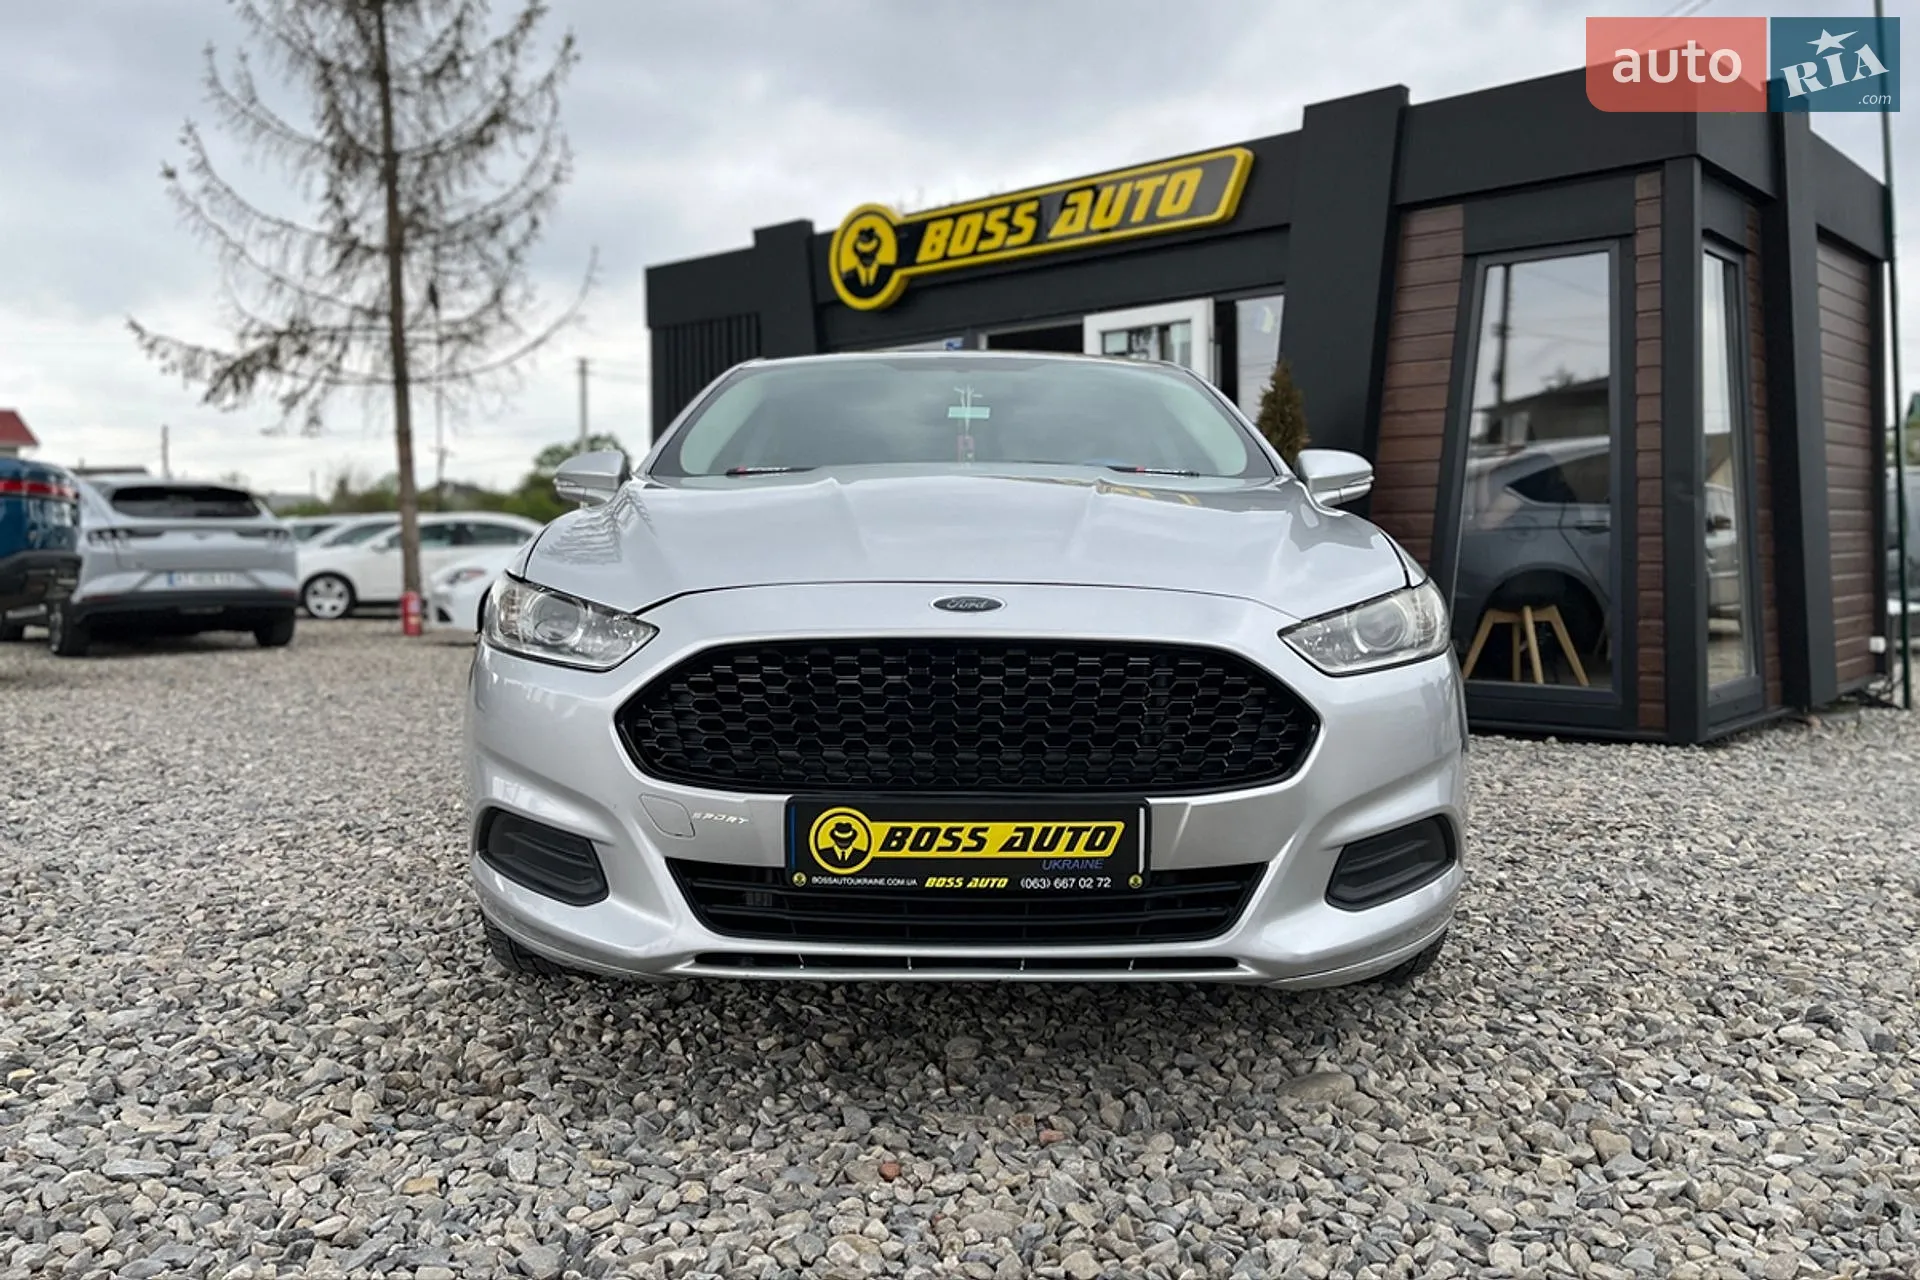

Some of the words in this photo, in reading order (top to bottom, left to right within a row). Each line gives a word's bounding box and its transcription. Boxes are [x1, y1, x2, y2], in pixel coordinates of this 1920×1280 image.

[915, 198, 1040, 264] BOSS
[1048, 167, 1203, 239] AUTO
[946, 598, 988, 610] Ford
[878, 825, 990, 853] BOSS
[997, 825, 1119, 853] AUTO
[1041, 859, 1105, 871] UKRAINE
[924, 876, 963, 888] BOSS
[966, 877, 1009, 888] AUTO
[1020, 877, 1051, 889] (063)
[1054, 877, 1075, 889] 667
[1078, 877, 1094, 889] 02
[1096, 876, 1112, 888] 72
